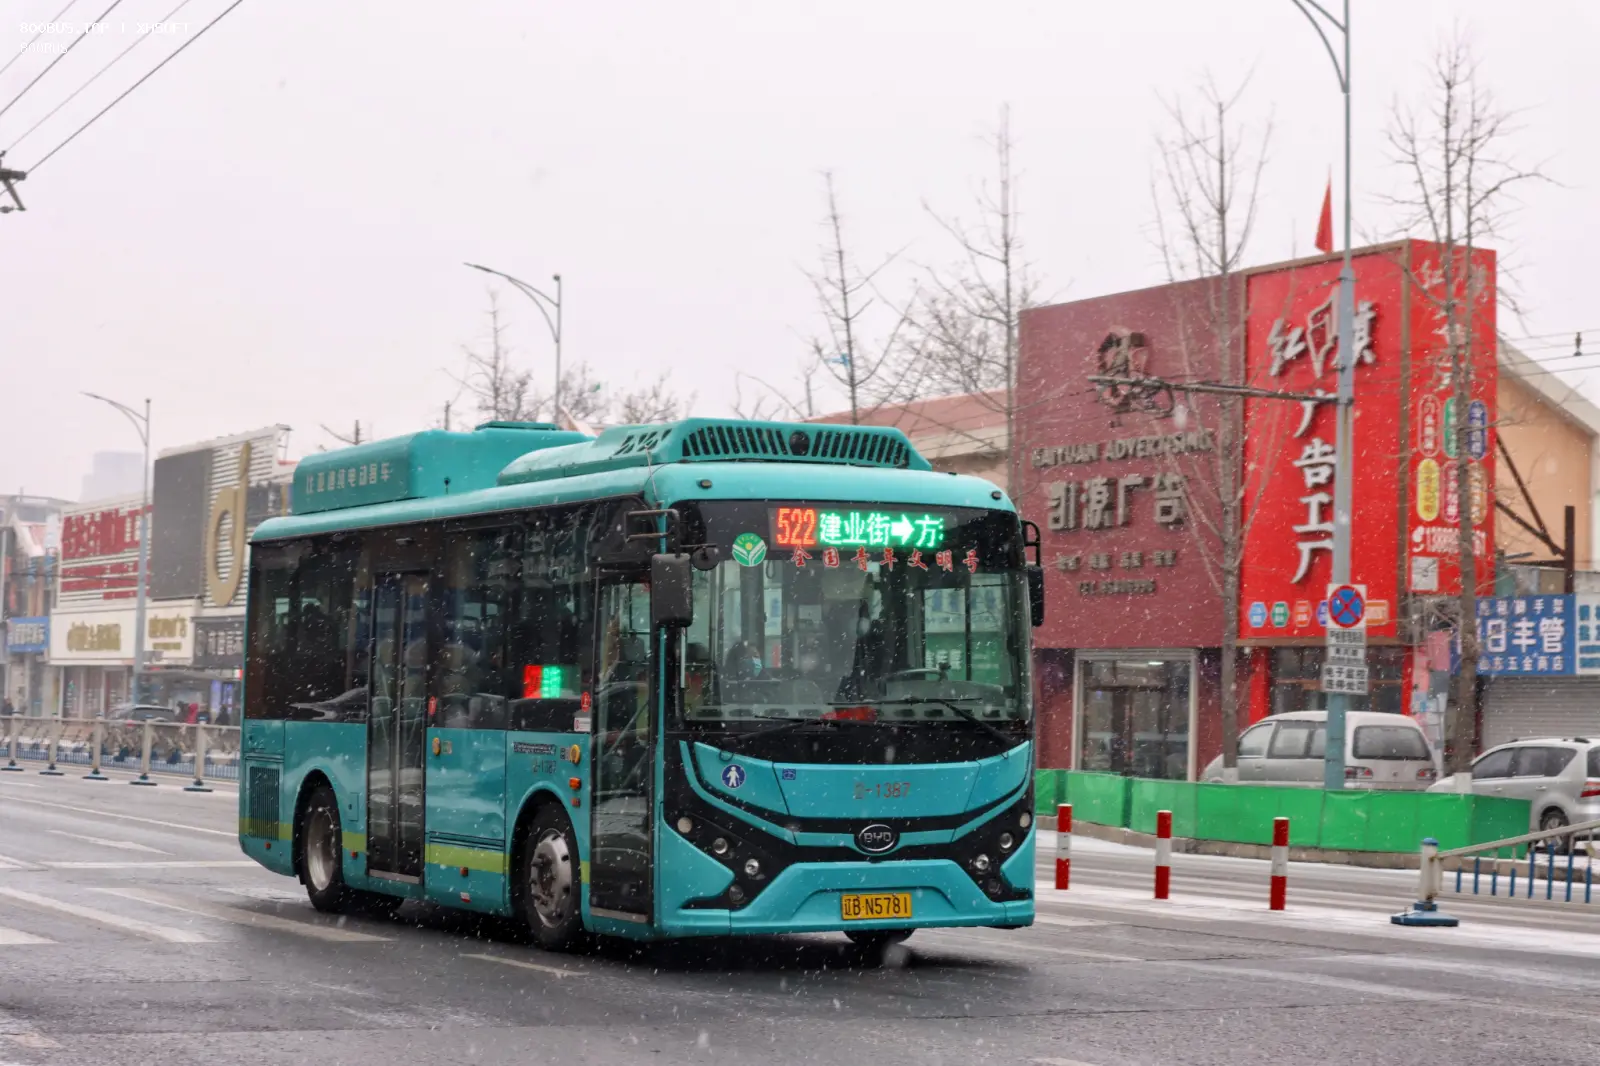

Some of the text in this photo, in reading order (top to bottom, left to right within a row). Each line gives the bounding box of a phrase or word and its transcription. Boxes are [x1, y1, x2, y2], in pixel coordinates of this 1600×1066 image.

[1291, 388, 1338, 585] 广告工厂
[776, 508, 817, 546] 522
[791, 546, 981, 573] 全国青年文明号
[863, 831, 892, 844] BYD
